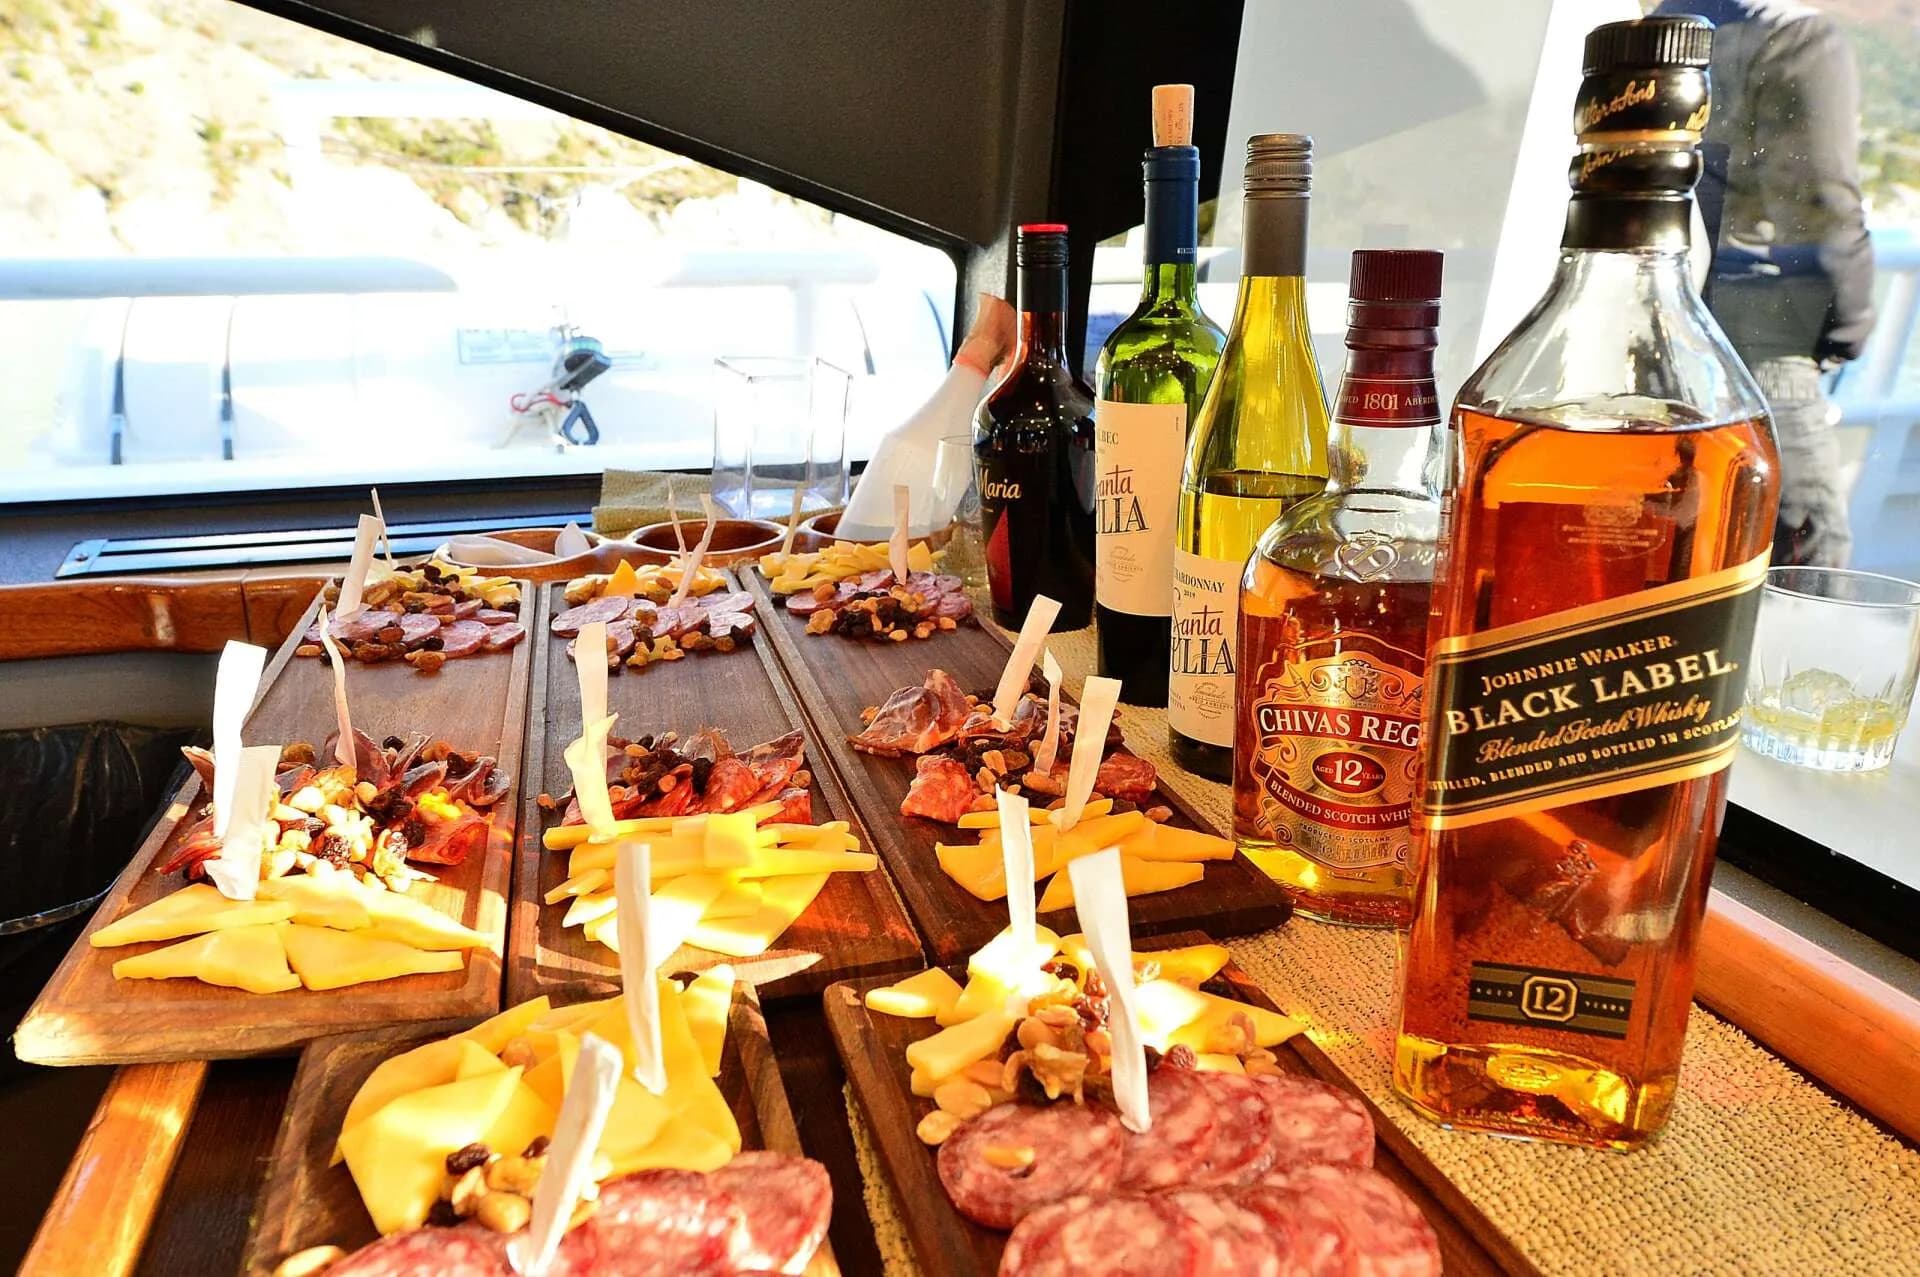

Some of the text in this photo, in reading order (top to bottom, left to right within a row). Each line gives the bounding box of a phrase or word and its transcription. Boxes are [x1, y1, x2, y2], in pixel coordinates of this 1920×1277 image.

[1363, 393, 1399, 410] 1801
[980, 467, 1021, 499] Maria
[1098, 464, 1134, 496] anta
[1172, 637, 1236, 674] ULIA
[1480, 657, 1578, 696] JOHNNIE
[1259, 708, 1421, 747] CHIVAS REG
[1446, 684, 1581, 736] BLACK
[1475, 694, 1711, 764] Blended Scotch Whisky
[1315, 765, 1334, 774] AGED
[1333, 759, 1363, 786] 12
[1489, 760, 1553, 782] BLENDED
[1558, 751, 1587, 767] AND
[1591, 737, 1656, 760] BOTTLED
[1659, 732, 1678, 745] IN
[1270, 780, 1412, 824] BLENDED SCOTCH WHIS
[1532, 985, 1567, 1012] 12
